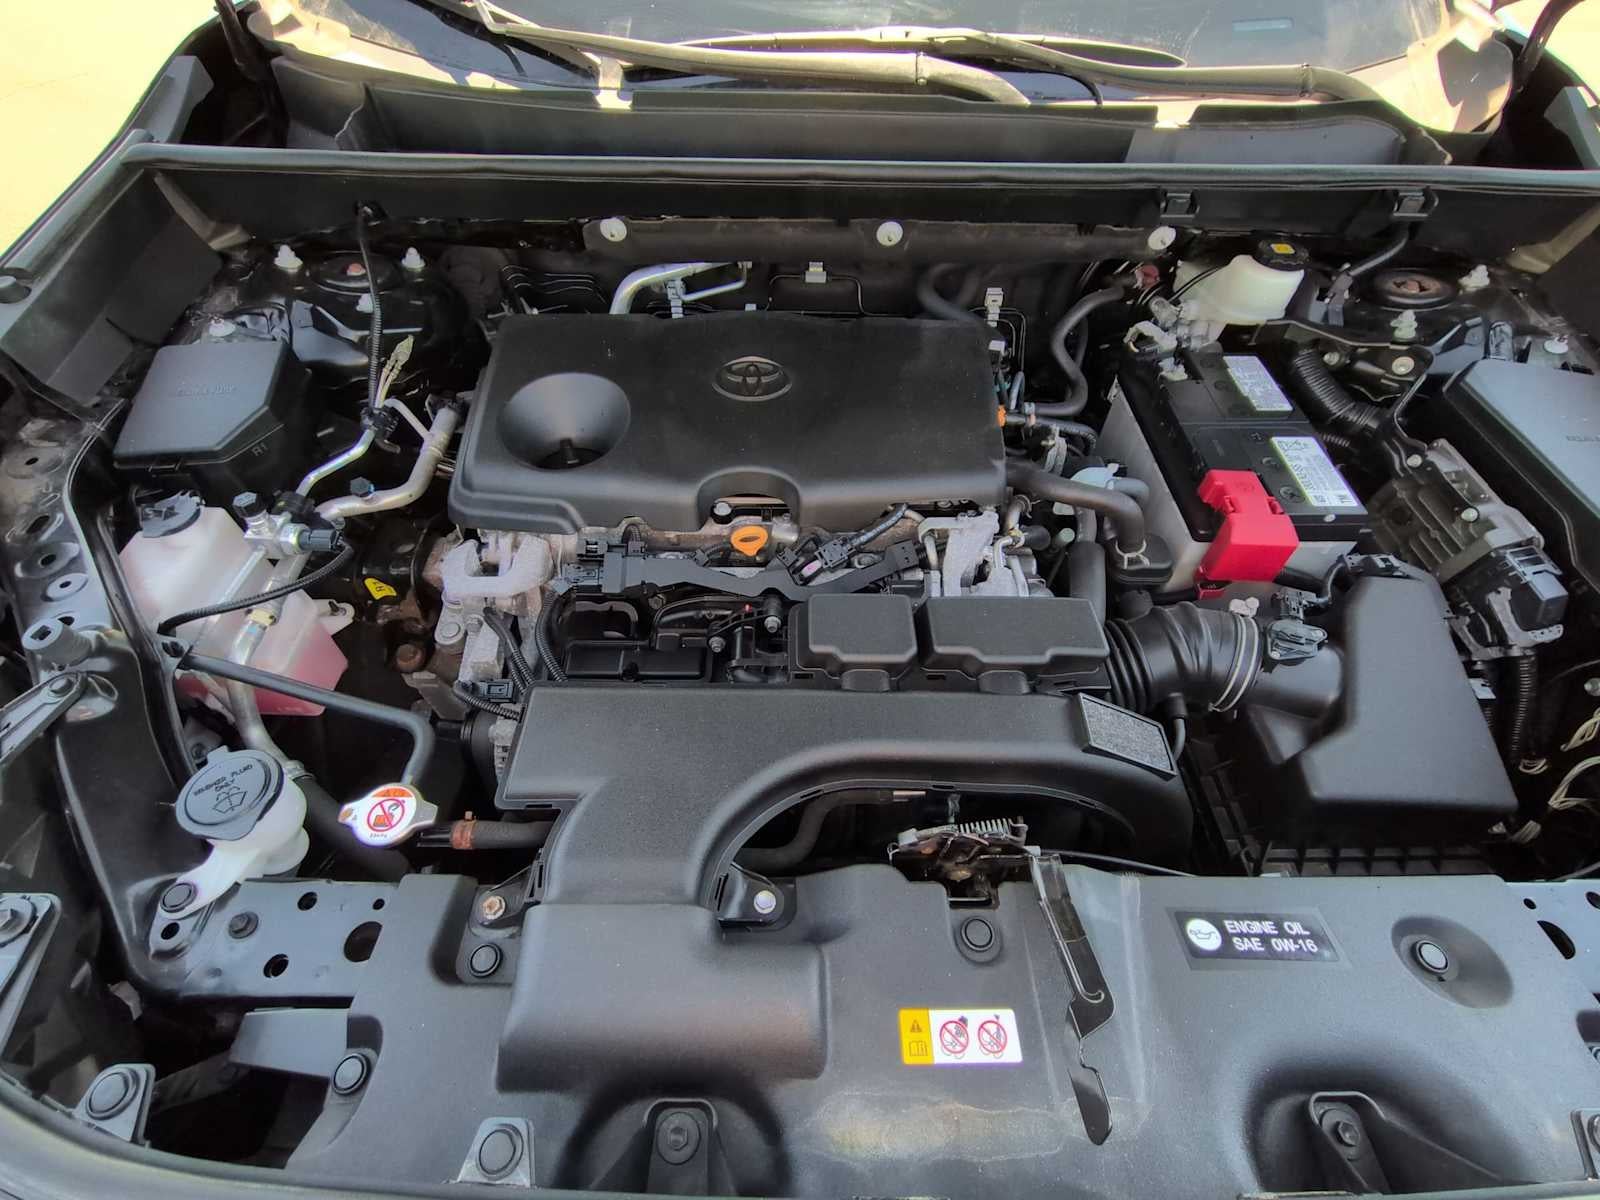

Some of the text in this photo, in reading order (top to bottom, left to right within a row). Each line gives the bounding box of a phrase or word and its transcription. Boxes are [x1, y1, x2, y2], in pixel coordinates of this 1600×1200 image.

[1223, 919, 1310, 936] ENGINE OIL
[1232, 936, 1318, 953] SAE 0W-16
